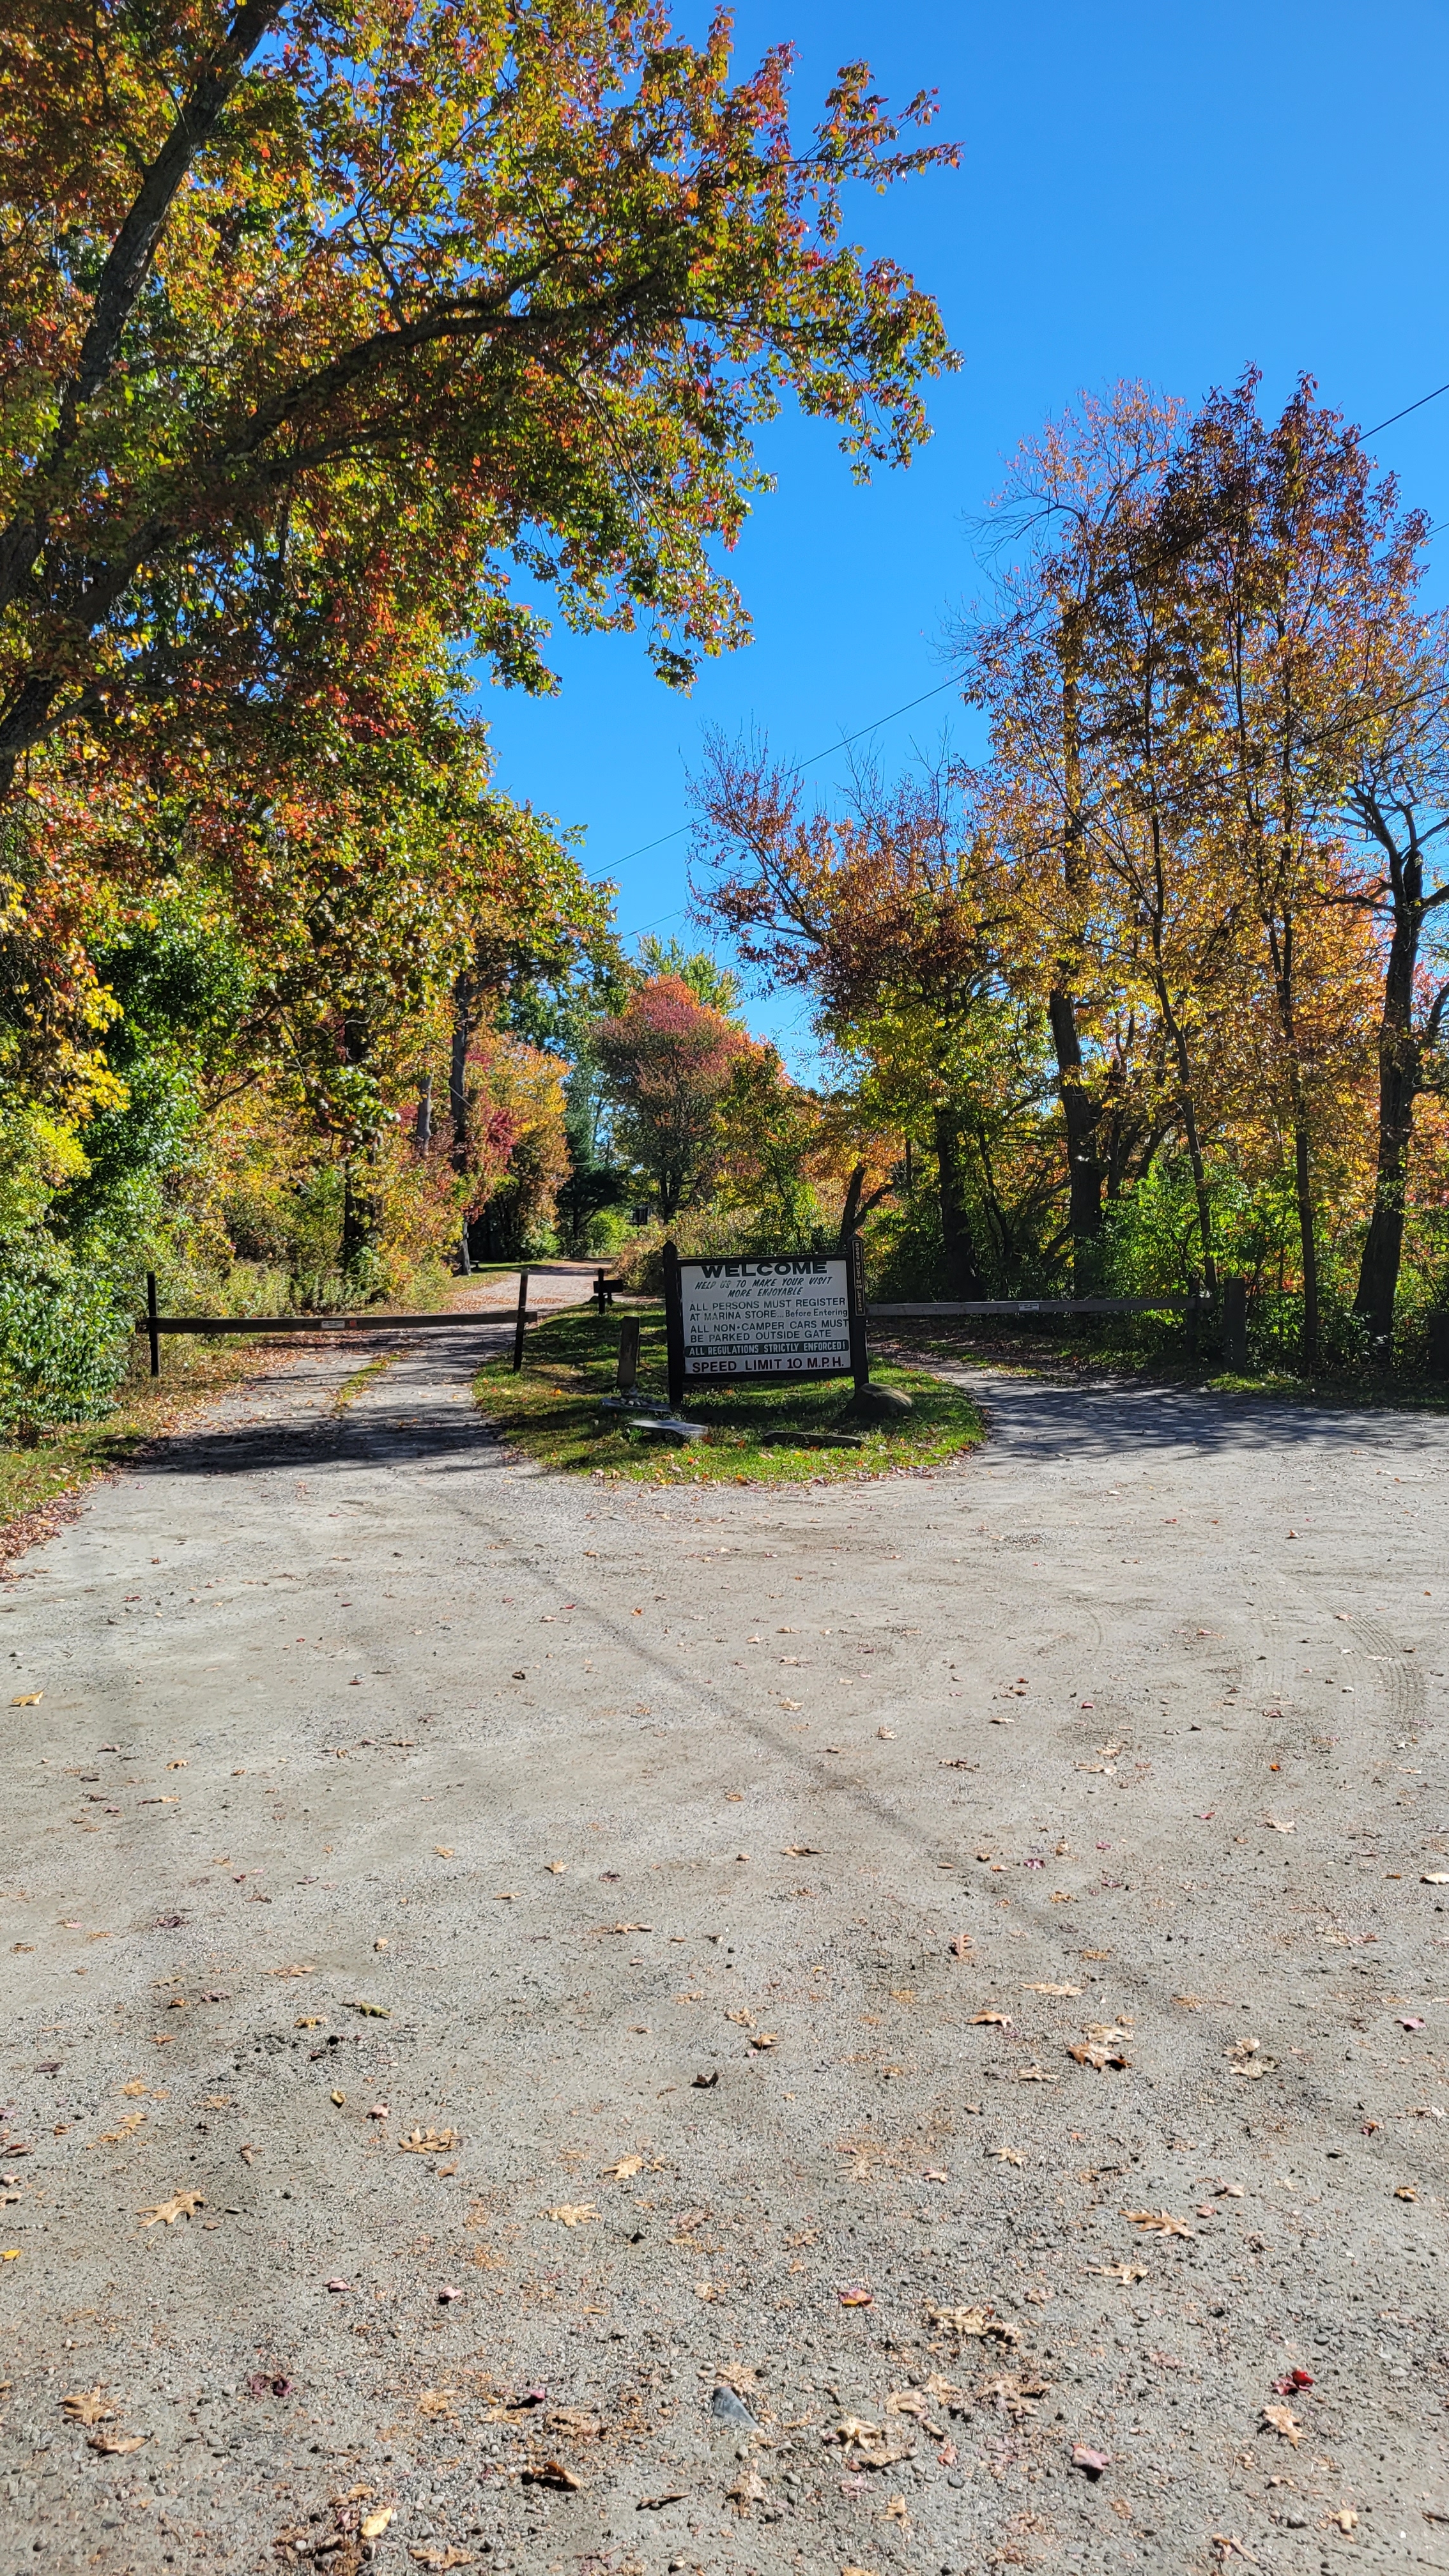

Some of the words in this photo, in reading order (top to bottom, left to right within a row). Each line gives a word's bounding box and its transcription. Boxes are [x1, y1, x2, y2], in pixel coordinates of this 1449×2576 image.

[701, 1262, 827, 1278] WELCOME
[695, 1281, 716, 1290] HELP
[720, 1280, 732, 1289] US
[752, 1278, 778, 1287] MAKE
[782, 1277, 804, 1286] YOUR
[809, 1276, 832, 1285] VISIT
[728, 1289, 753, 1298] MORE
[757, 1287, 803, 1297] ENJOYABLE
[689, 1303, 708, 1311] ALL
[712, 1301, 760, 1310] PERSONS
[764, 1300, 792, 1308] MUST
[795, 1298, 845, 1308] REGISTER
[704, 1312, 741, 1321] MARINA
[785, 1309, 811, 1317] Before
[813, 1308, 848, 1317] Entering
[691, 1325, 709, 1333] ALL
[790, 1321, 816, 1329] CARS
[821, 1319, 849, 1328] MUST
[691, 1335, 703, 1343] BE
[709, 1333, 750, 1342] PARKED
[755, 1331, 800, 1340] OUTSIDE
[804, 1330, 831, 1338] GATE
[689, 1347, 705, 1356] ALL
[708, 1344, 759, 1355] REGULATIONS
[763, 1343, 799, 1353] STRICTLY
[803, 1341, 845, 1351] ENFORCED!
[692, 1360, 737, 1373] SPEED
[745, 1359, 782, 1370] LIMIT
[787, 1358, 802, 1368] 10
